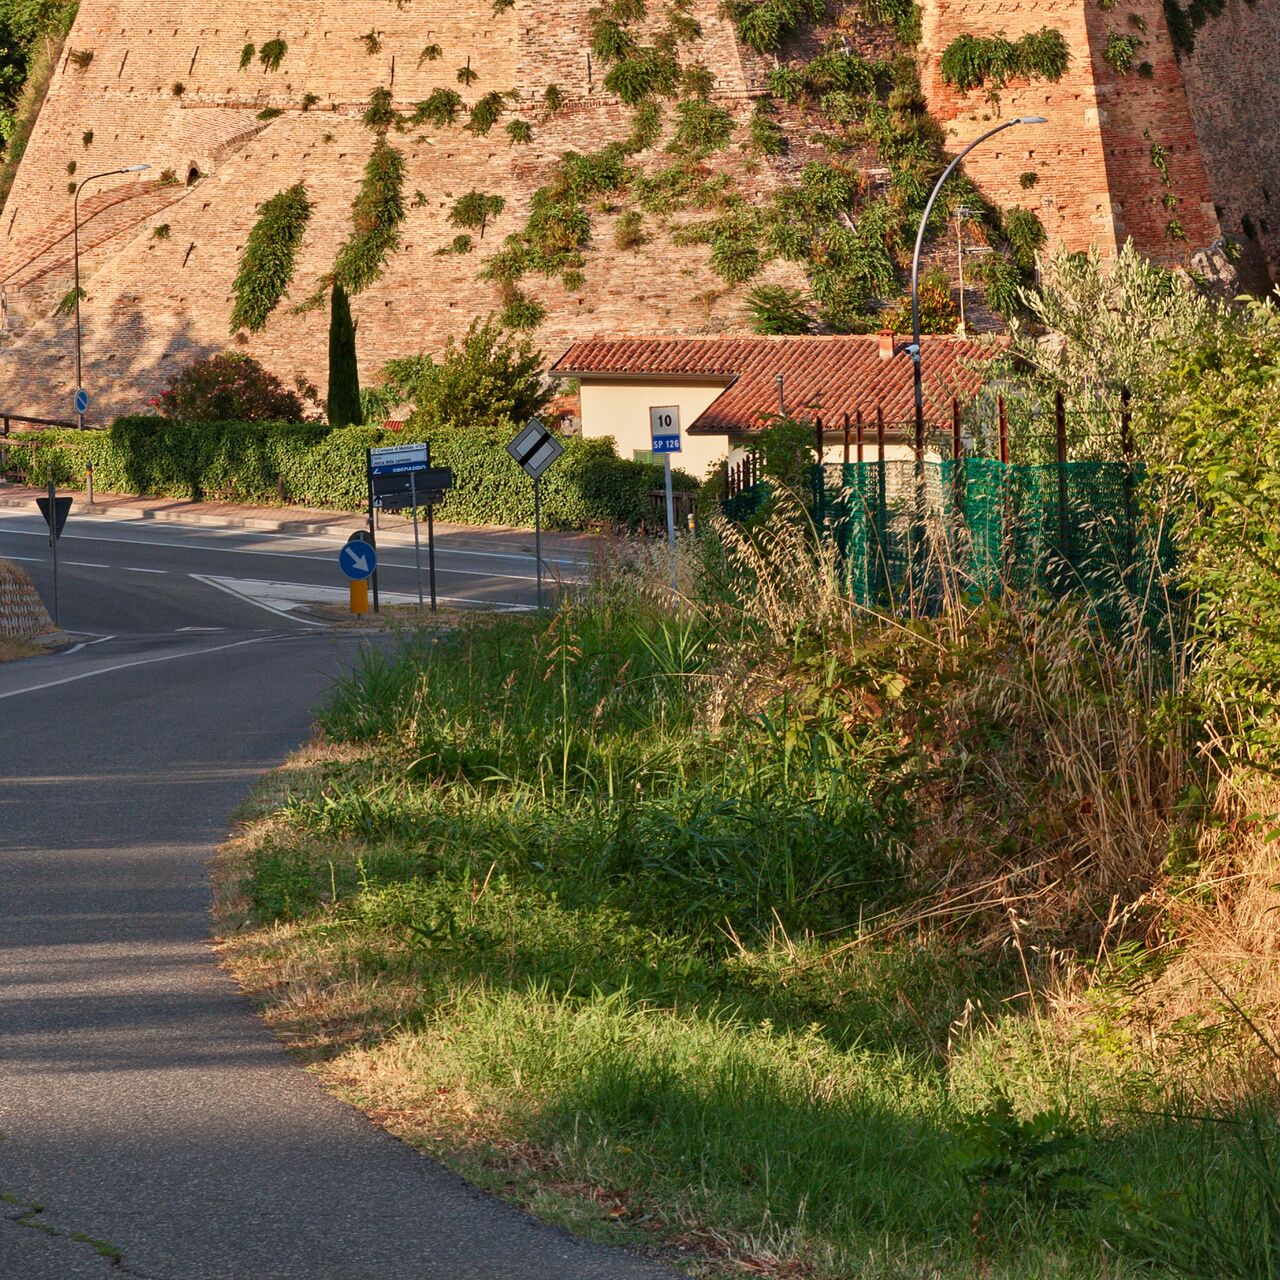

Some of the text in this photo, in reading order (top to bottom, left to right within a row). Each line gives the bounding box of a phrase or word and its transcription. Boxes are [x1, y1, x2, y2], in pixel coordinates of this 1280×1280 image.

[658, 414, 672, 428] 10
[653, 439, 680, 449] SP 126
